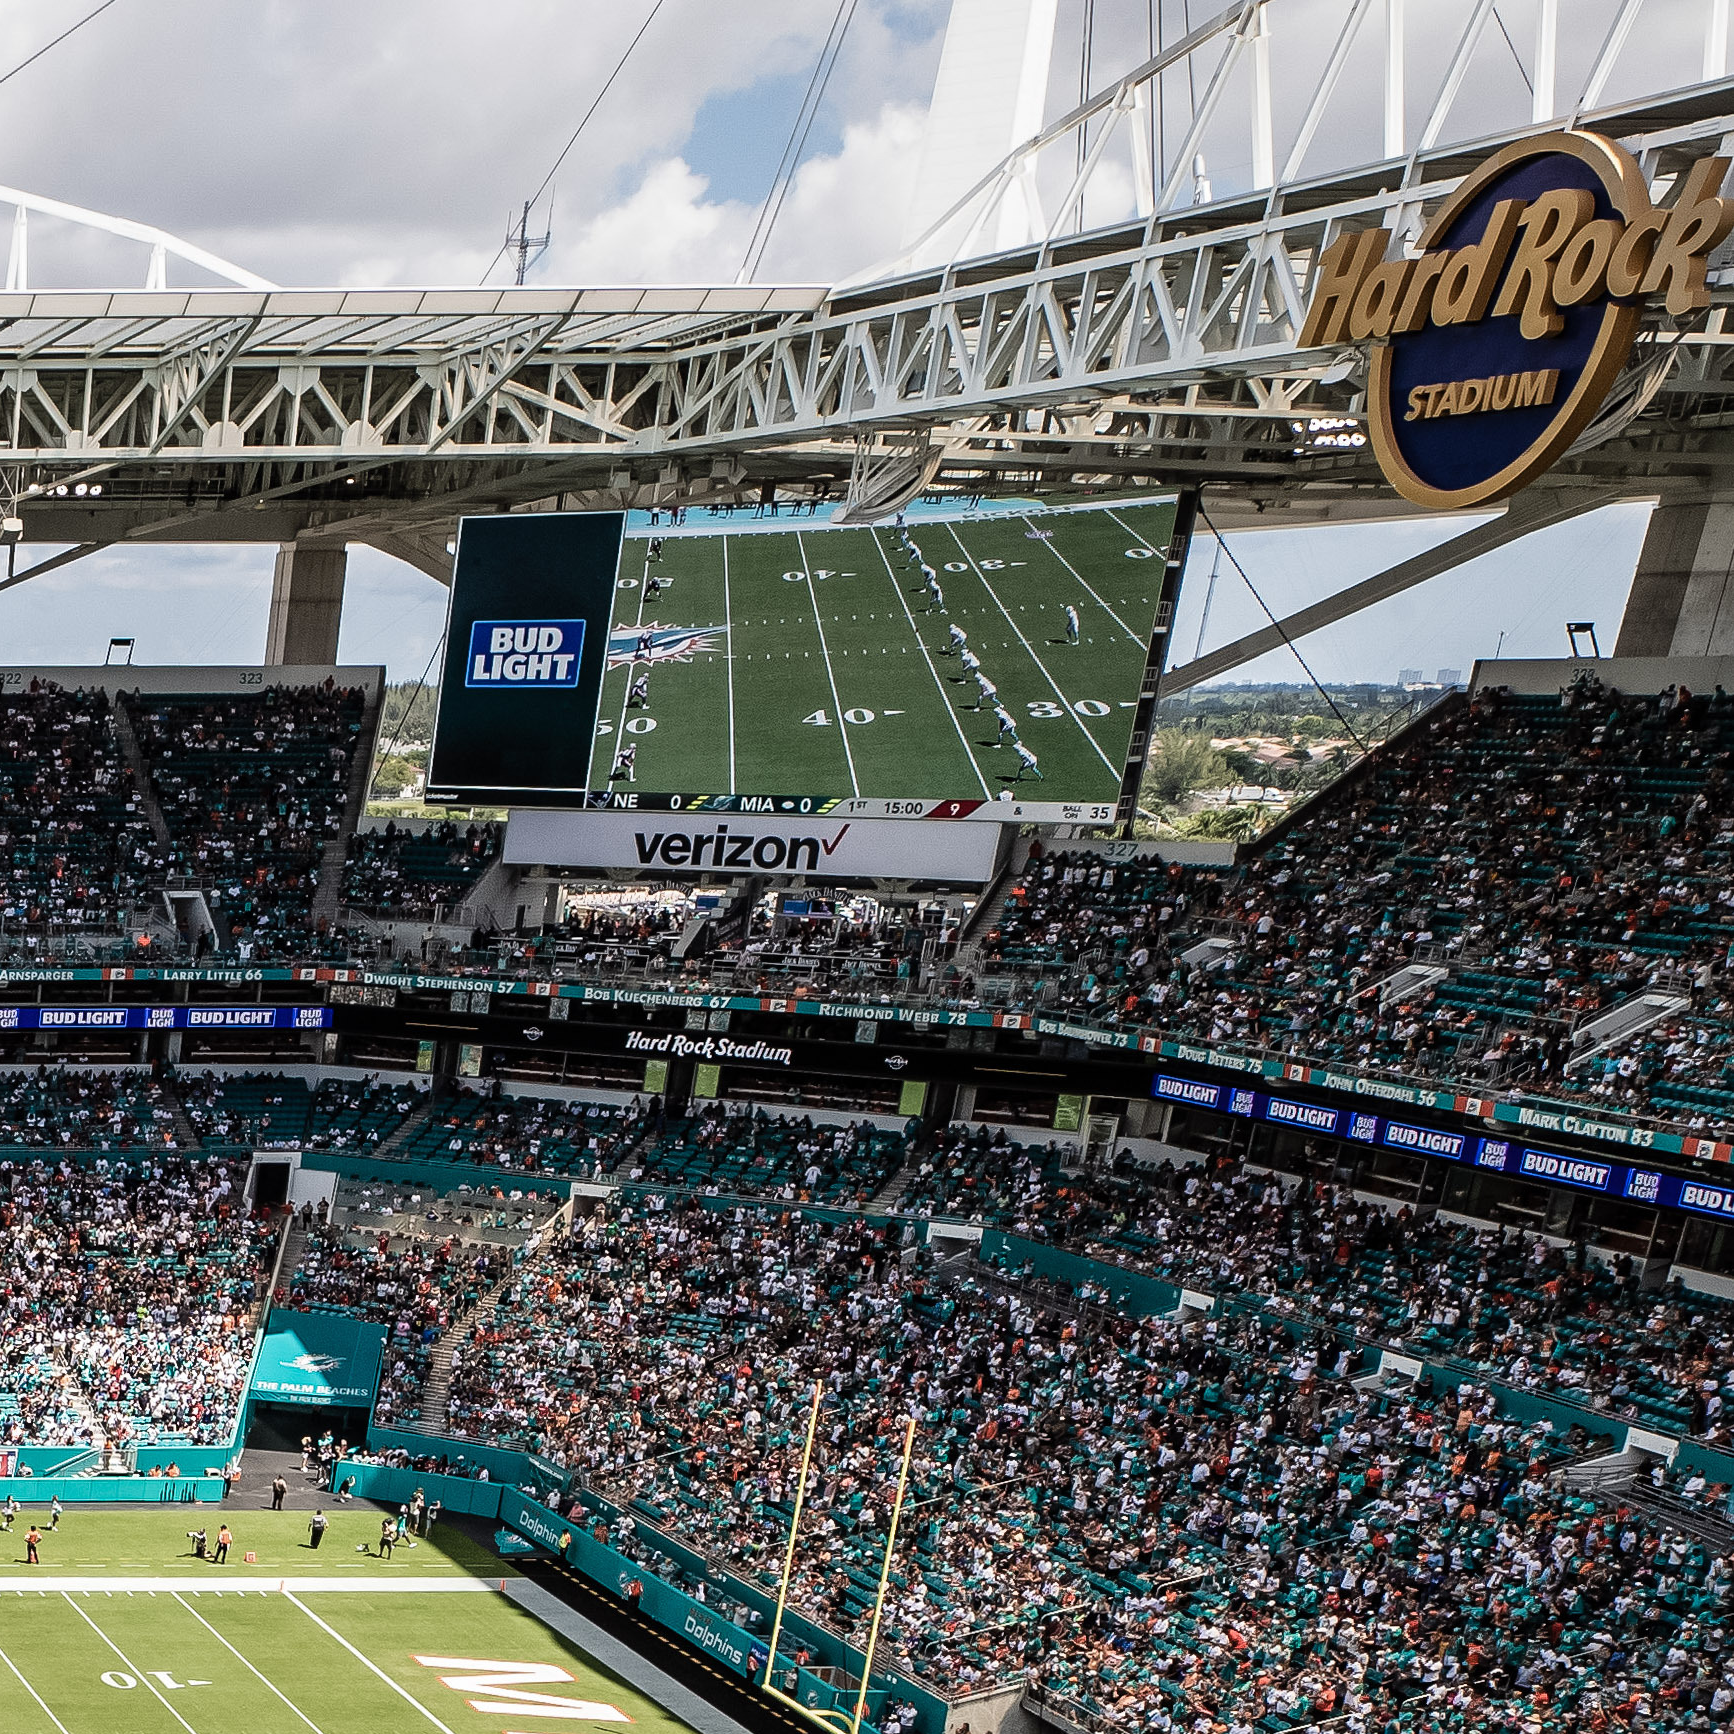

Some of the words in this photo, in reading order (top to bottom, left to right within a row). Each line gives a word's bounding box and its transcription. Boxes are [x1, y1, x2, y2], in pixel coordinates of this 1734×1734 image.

[1296, 199, 1528, 349] Hard
[1492, 156, 1734, 340] Rock
[1404, 369, 1561, 423] STADIUM
[490, 627, 563, 653] BUD
[472, 654, 575, 680] LIGHT
[614, 793, 638, 808] NE
[670, 795, 681, 809] 0
[740, 797, 775, 812] MIA
[800, 797, 811, 812] 0
[848, 800, 868, 812] 1ST
[884, 802, 923, 814] 15:00
[950, 803, 960, 815] 9
[1089, 807, 1110, 820] 35
[634, 824, 820, 870] verizon
[1103, 841, 1138, 859] 327
[163, 970, 202, 981] LARRY
[206, 970, 242, 980] LITTLE
[245, 970, 262, 980] 66
[363, 972, 413, 987] DWIGHT
[416, 976, 493, 992] STEPHENSON
[497, 981, 515, 994] 57
[584, 987, 610, 1001] BOB
[613, 989, 703, 1008] KUECHENBERG
[709, 996, 731, 1009] 67
[819, 1003, 894, 1020] RICHMOND
[899, 1009, 940, 1024] WEBB
[947, 1012, 968, 1026] 78
[626, 1031, 672, 1052] Hard
[672, 1034, 715, 1059] Rock
[715, 1038, 792, 1066] Stadium
[1322, 1072, 1353, 1091] JOHN
[1418, 1090, 1437, 1107] 56
[1269, 1100, 1296, 1120] BUD
[1296, 1106, 1336, 1128] LIGHT
[1519, 1107, 1560, 1130] MARK
[1563, 1115, 1627, 1144] CLAYTON
[1630, 1128, 1654, 1148] 83
[1524, 1153, 1558, 1175] BUD
[1558, 1160, 1608, 1185] LIGHT
[683, 1615, 743, 1665] Dolphins
